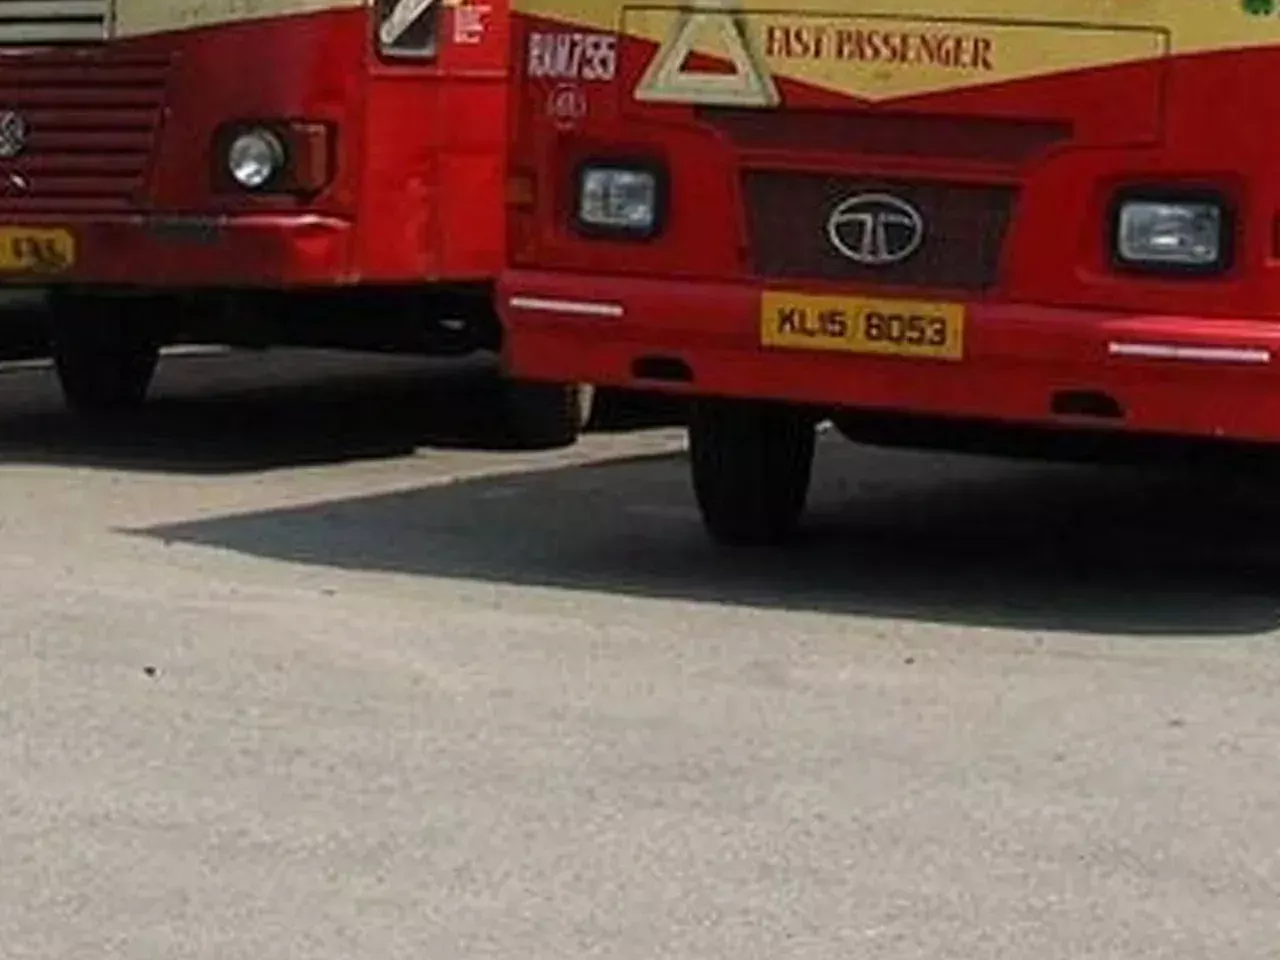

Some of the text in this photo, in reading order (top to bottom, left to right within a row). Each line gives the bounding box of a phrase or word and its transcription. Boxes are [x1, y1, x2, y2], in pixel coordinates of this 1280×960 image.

[765, 24, 994, 71] FAST PASSENGER
[777, 306, 948, 346] KL15 8053
